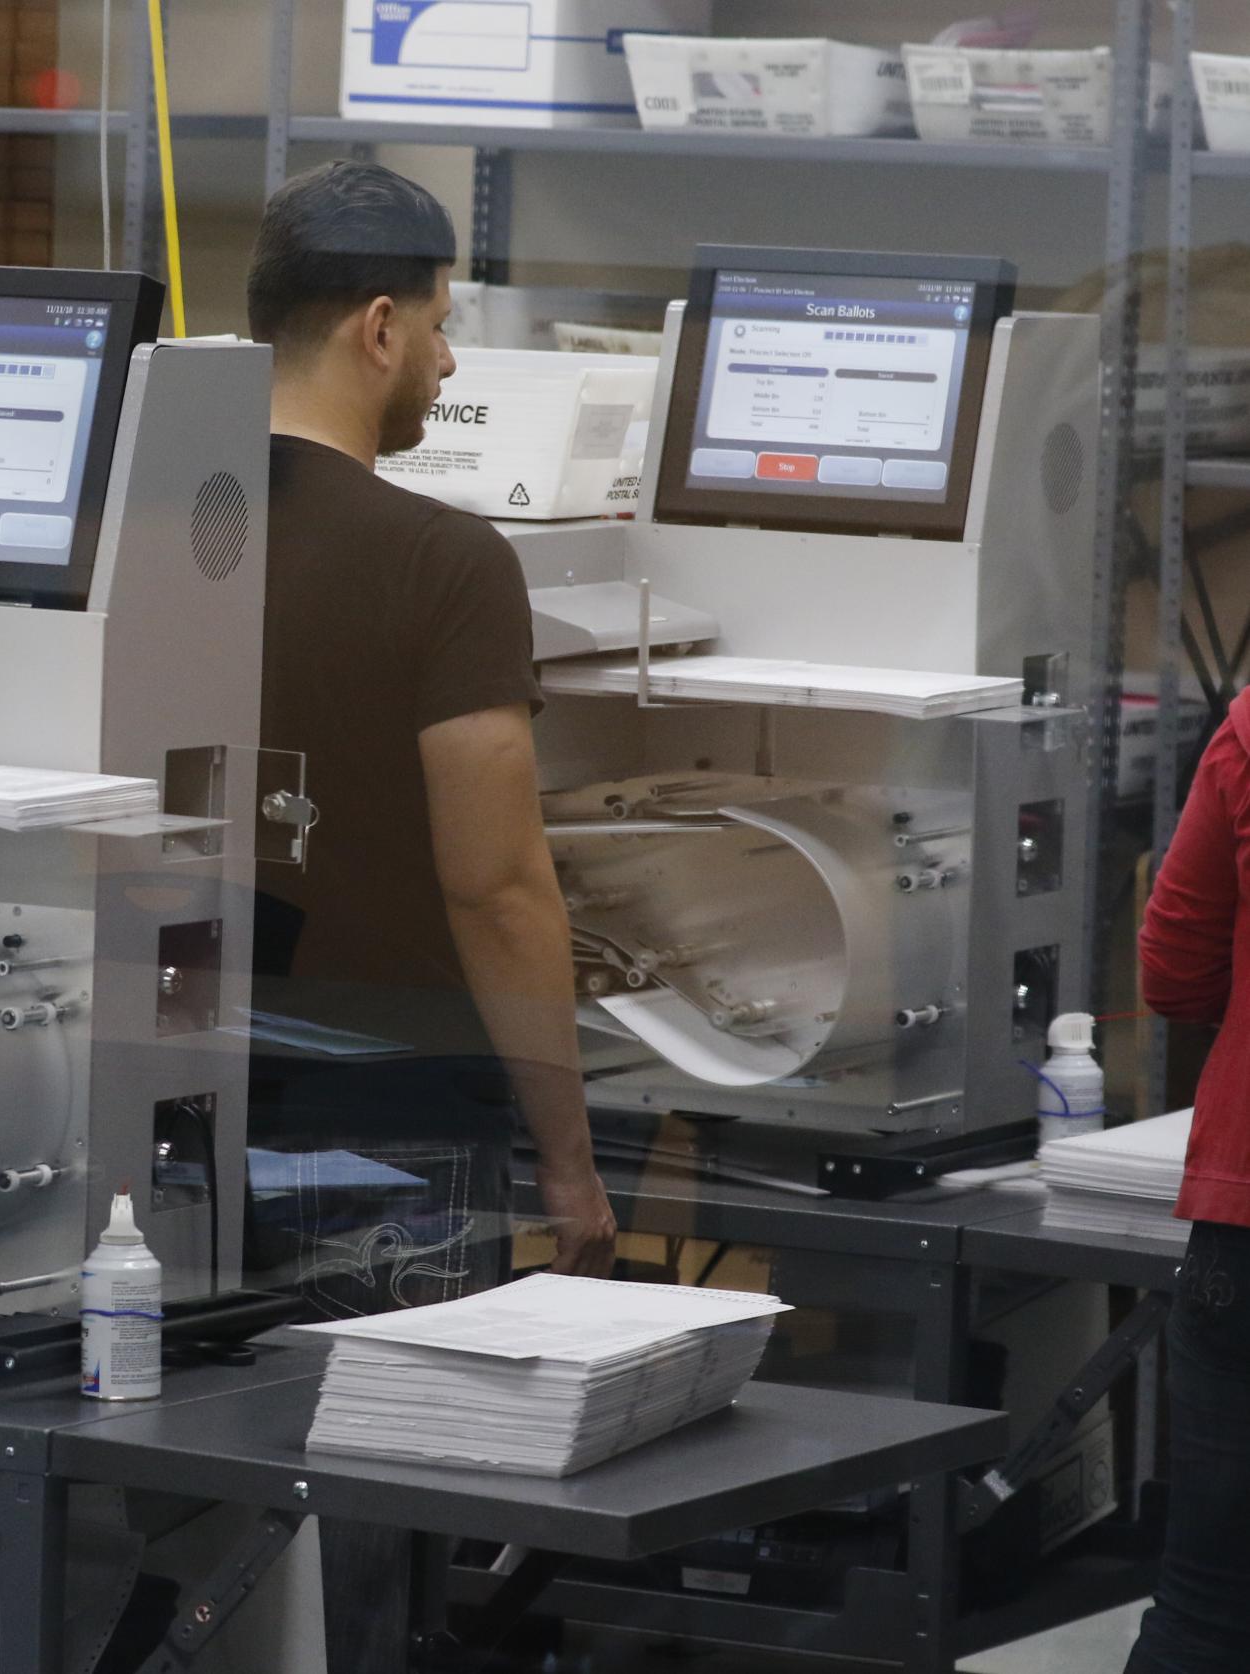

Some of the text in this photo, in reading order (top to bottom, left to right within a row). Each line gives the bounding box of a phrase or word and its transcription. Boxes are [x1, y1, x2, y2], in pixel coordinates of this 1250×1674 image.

[806, 303, 875, 319] Scan Ballots
[426, 403, 489, 424] RVICE
[777, 462, 796, 474] Stop
